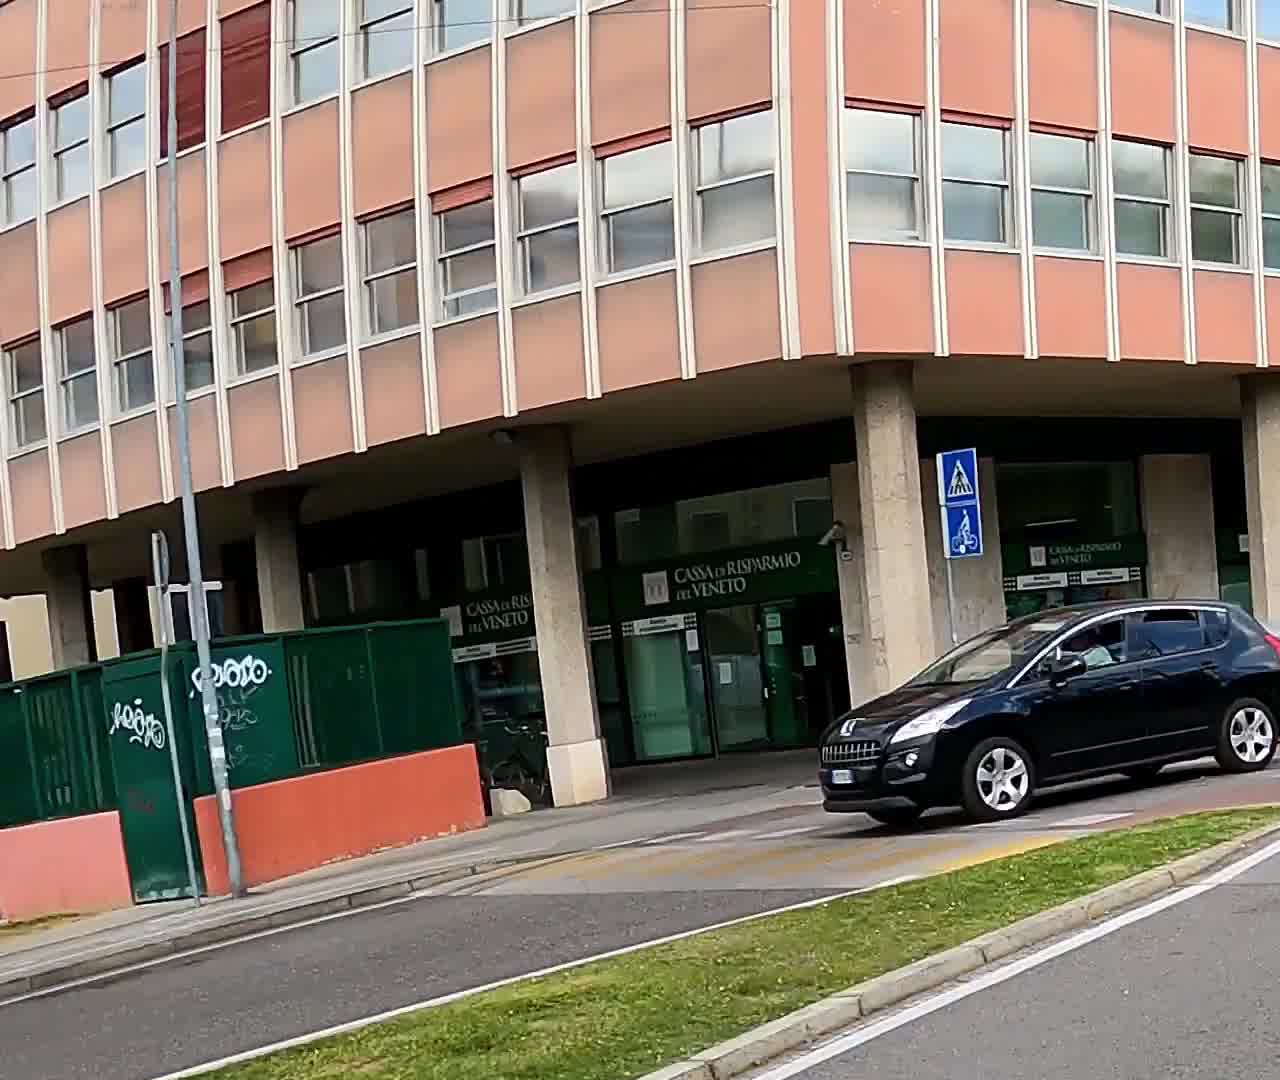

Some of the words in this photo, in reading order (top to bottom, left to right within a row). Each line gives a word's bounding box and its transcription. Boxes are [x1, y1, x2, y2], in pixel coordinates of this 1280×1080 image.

[674, 564, 714, 583] CASSA
[727, 551, 801, 575] RISPARMIO
[691, 577, 747, 597] VENETO
[466, 599, 501, 616] CASSA
[481, 610, 528, 630] VENETO
